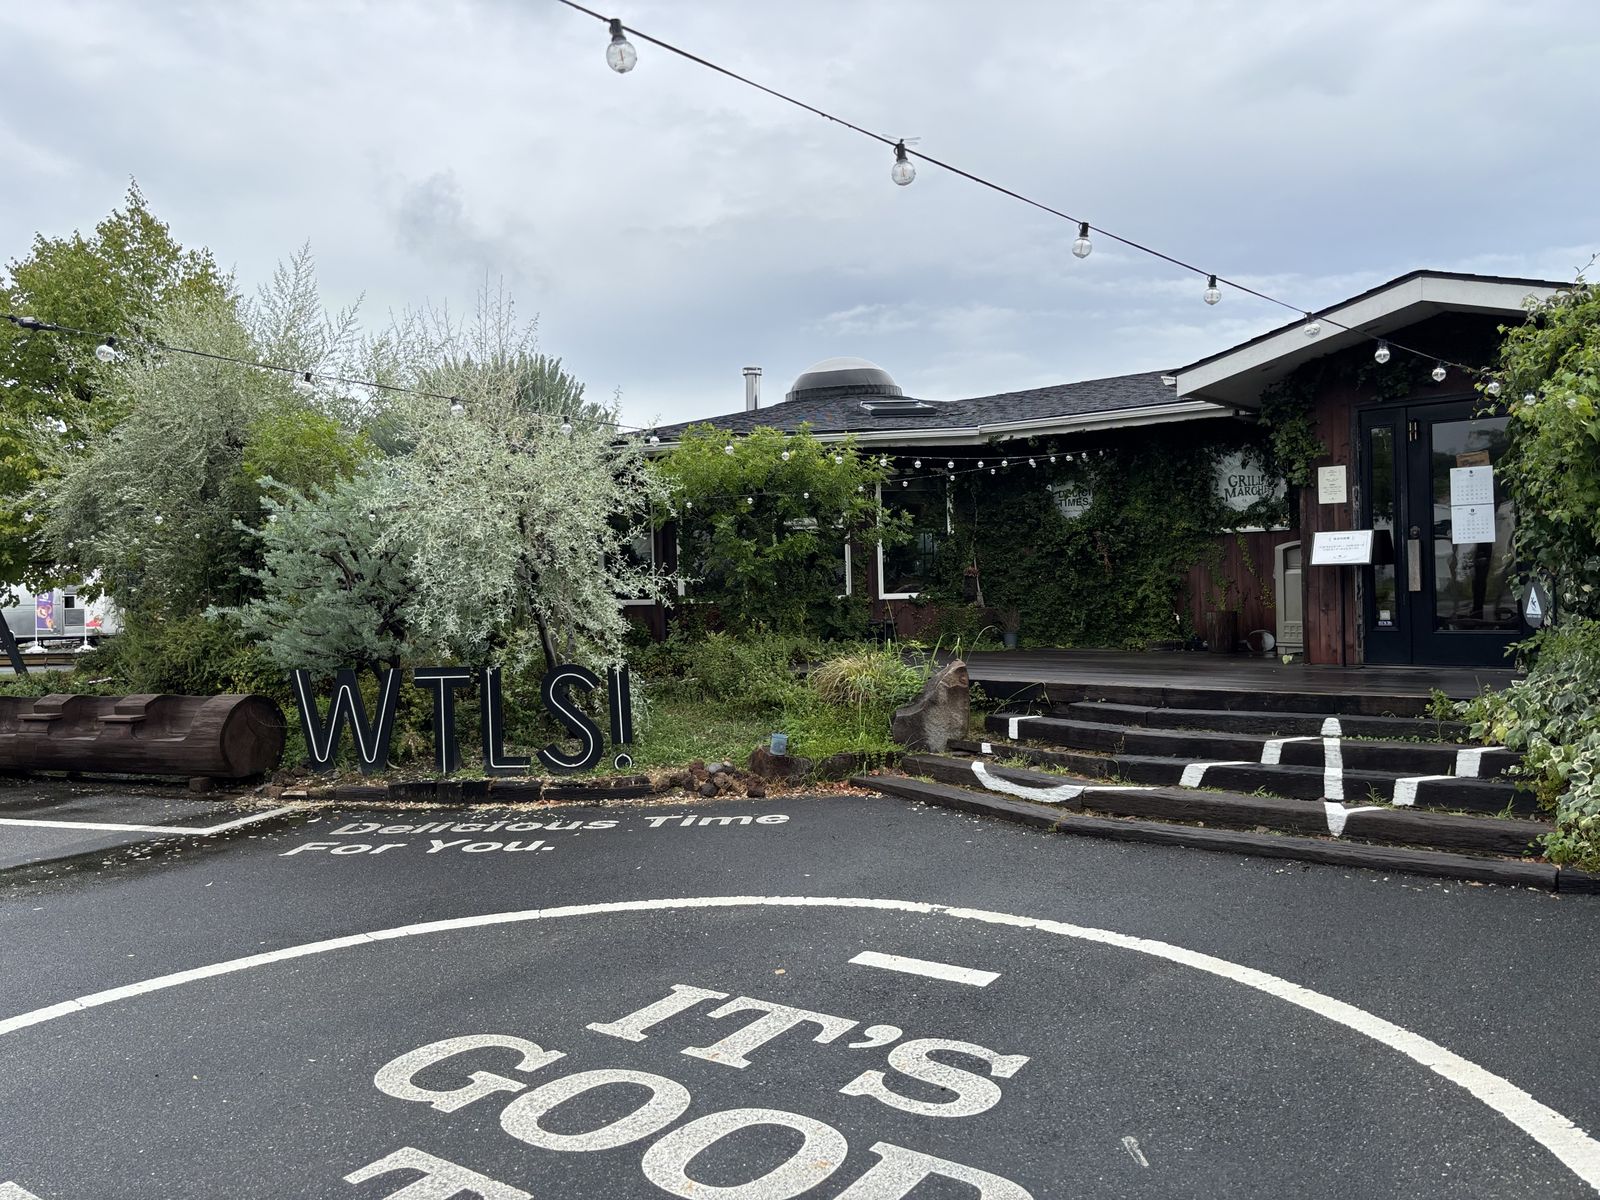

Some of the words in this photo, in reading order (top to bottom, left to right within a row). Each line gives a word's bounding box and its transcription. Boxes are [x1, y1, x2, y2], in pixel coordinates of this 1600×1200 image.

[1227, 474, 1265, 488] GRILL
[1058, 498, 1089, 507] TIMES
[329, 820, 620, 835] Delicious
[644, 814, 790, 828] Time
[278, 841, 408, 857] For
[426, 839, 555, 854] You.
[585, 984, 1030, 1118] IT'S
